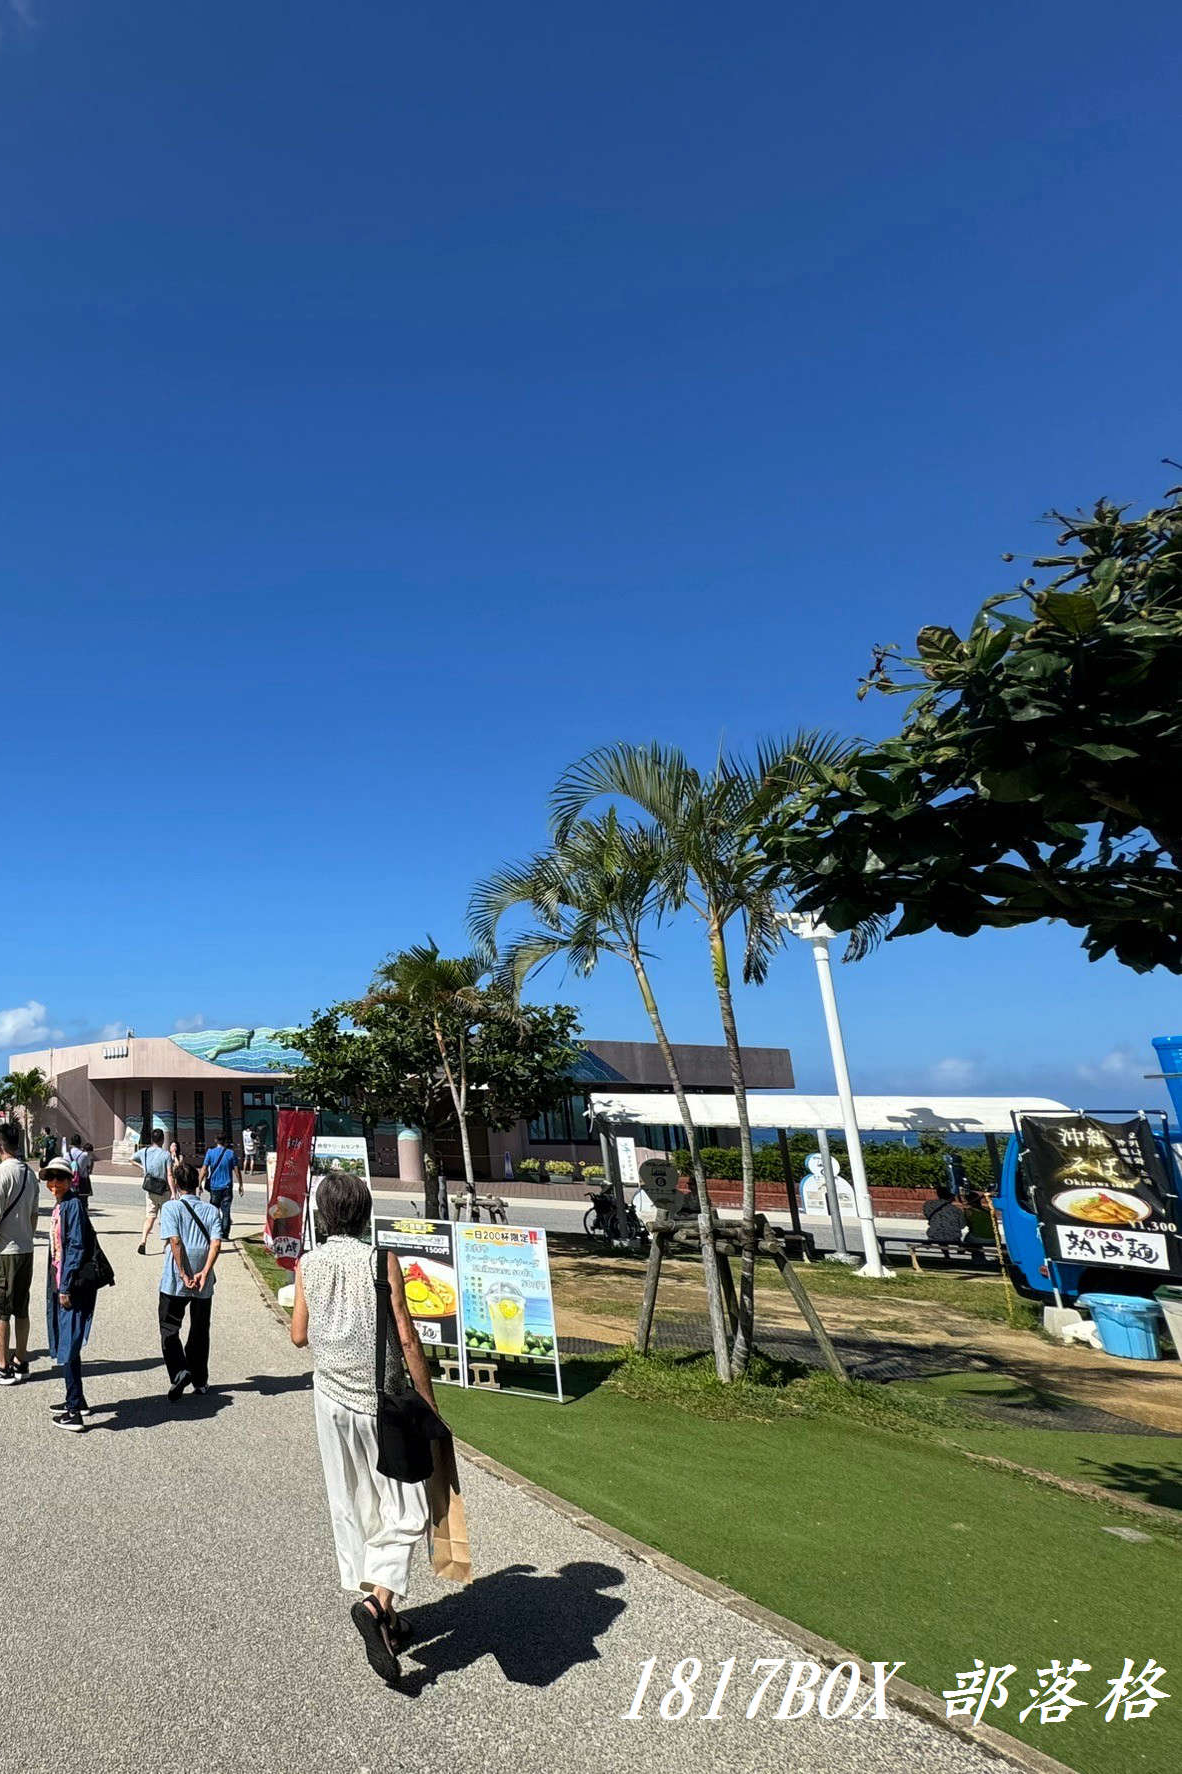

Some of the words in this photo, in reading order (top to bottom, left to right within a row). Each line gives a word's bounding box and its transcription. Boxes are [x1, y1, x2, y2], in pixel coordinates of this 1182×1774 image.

[1058, 1127, 1113, 1148] 沖縄
[1072, 1156, 1120, 1176] そば
[1063, 1178, 1109, 1188] Okinawa
